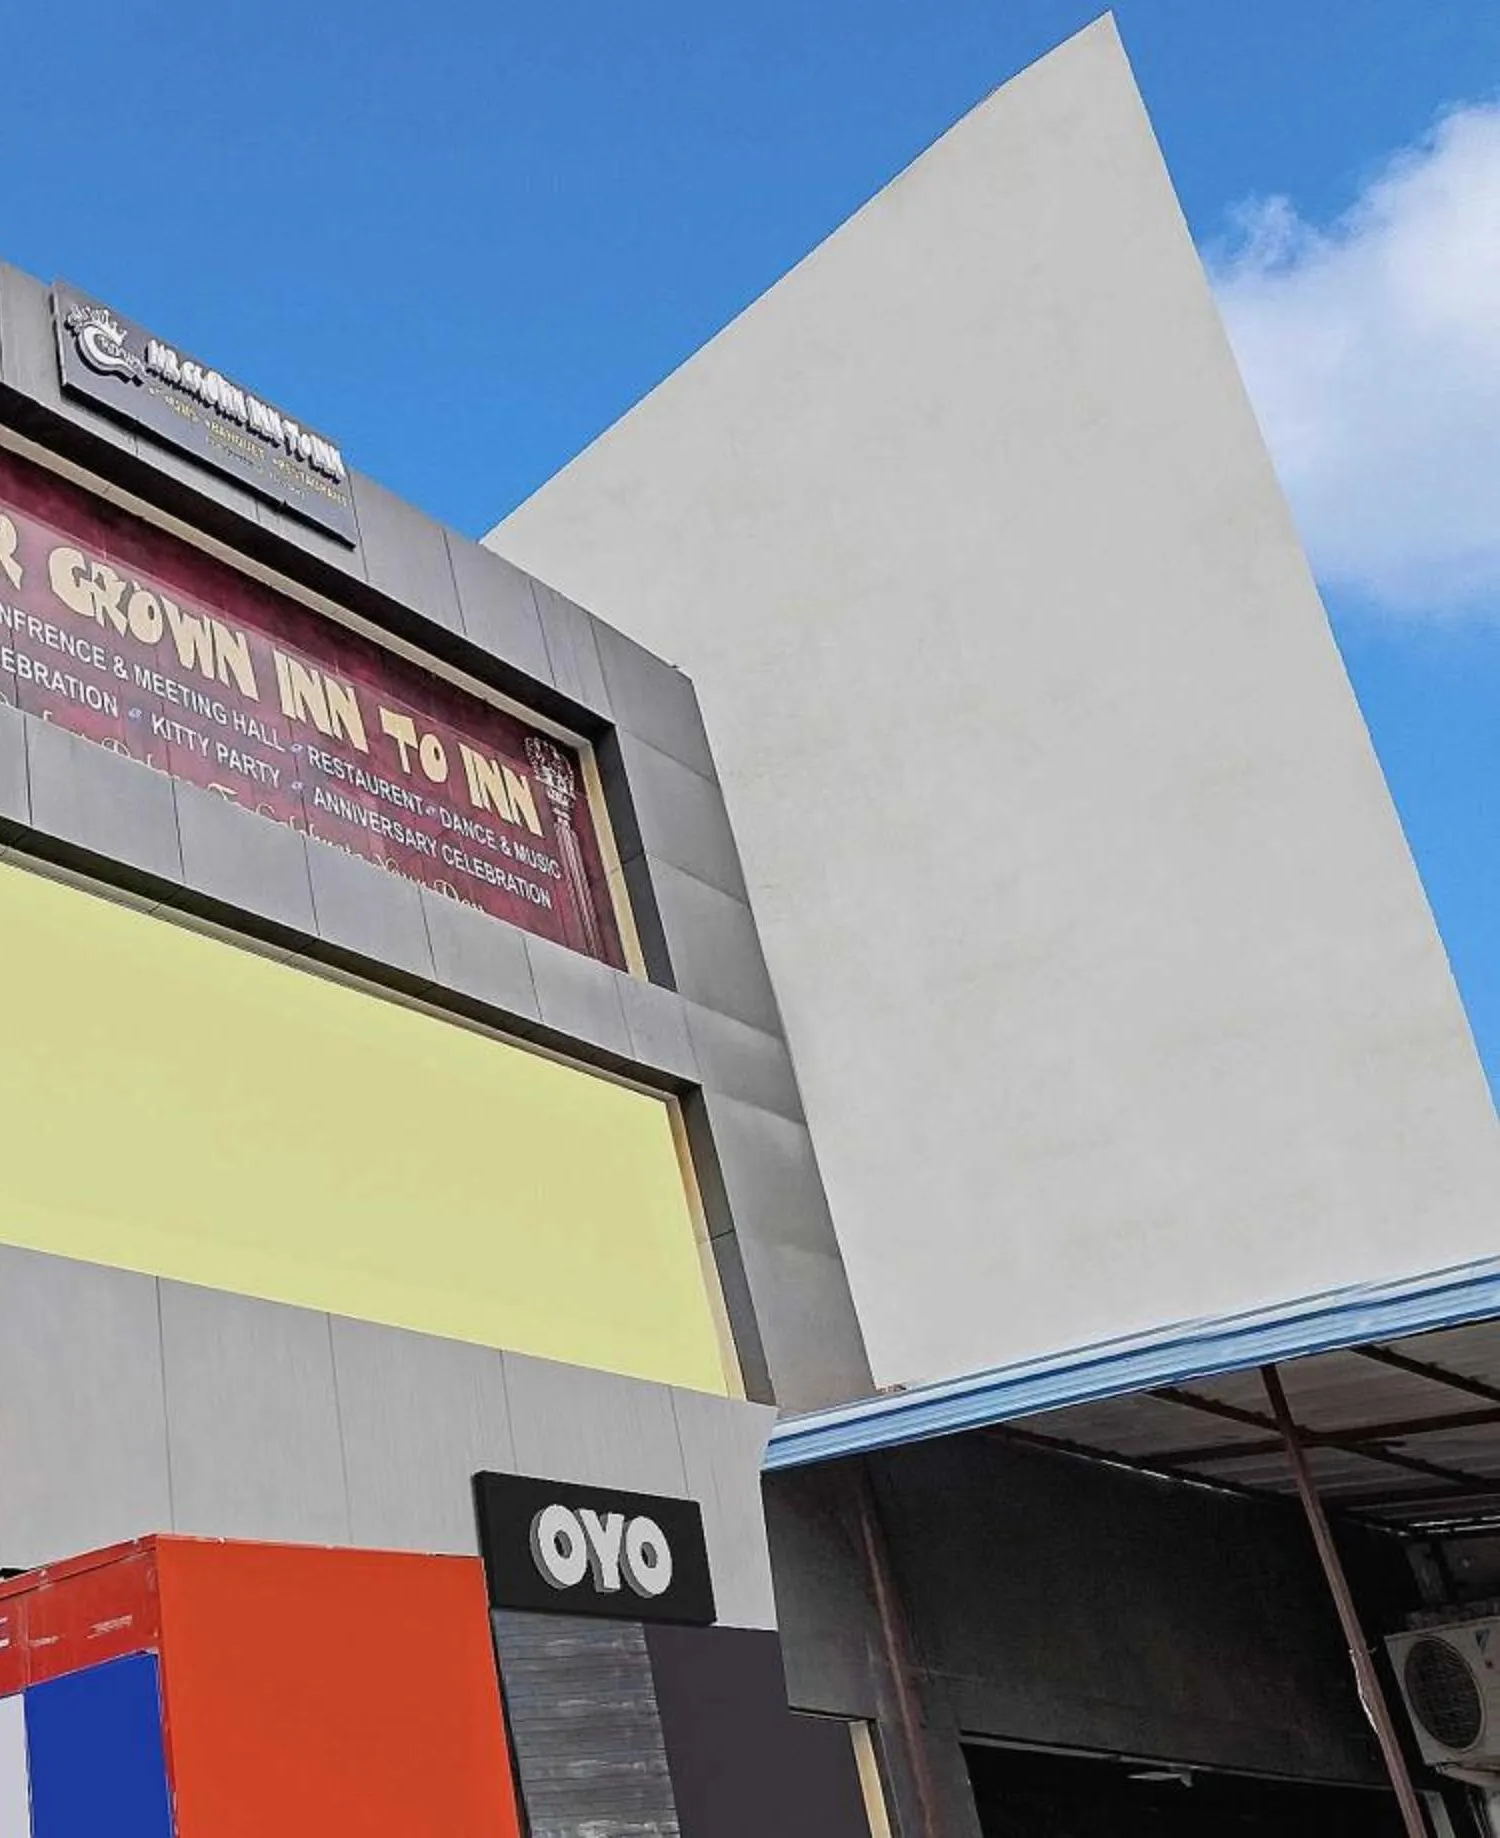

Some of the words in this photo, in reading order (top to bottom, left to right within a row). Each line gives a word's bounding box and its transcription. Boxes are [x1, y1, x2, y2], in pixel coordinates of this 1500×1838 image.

[113, 653, 130, 681] &
[134, 665, 228, 727] MEETING
[233, 708, 285, 753] HALL
[307, 745, 425, 816] RESTAURENT
[440, 806, 498, 848] DANCE
[500, 835, 513, 855] &
[513, 838, 563, 880] MUSIC
[151, 713, 210, 757] KITTY
[216, 742, 281, 788] PARTY
[313, 786, 438, 857] ANNIVERSARY
[441, 844, 553, 909] CELEBRATION
[273, 648, 370, 753] INN
[380, 705, 449, 783] TO
[458, 742, 546, 838] INN
[529, 1503, 673, 1599] OYO
